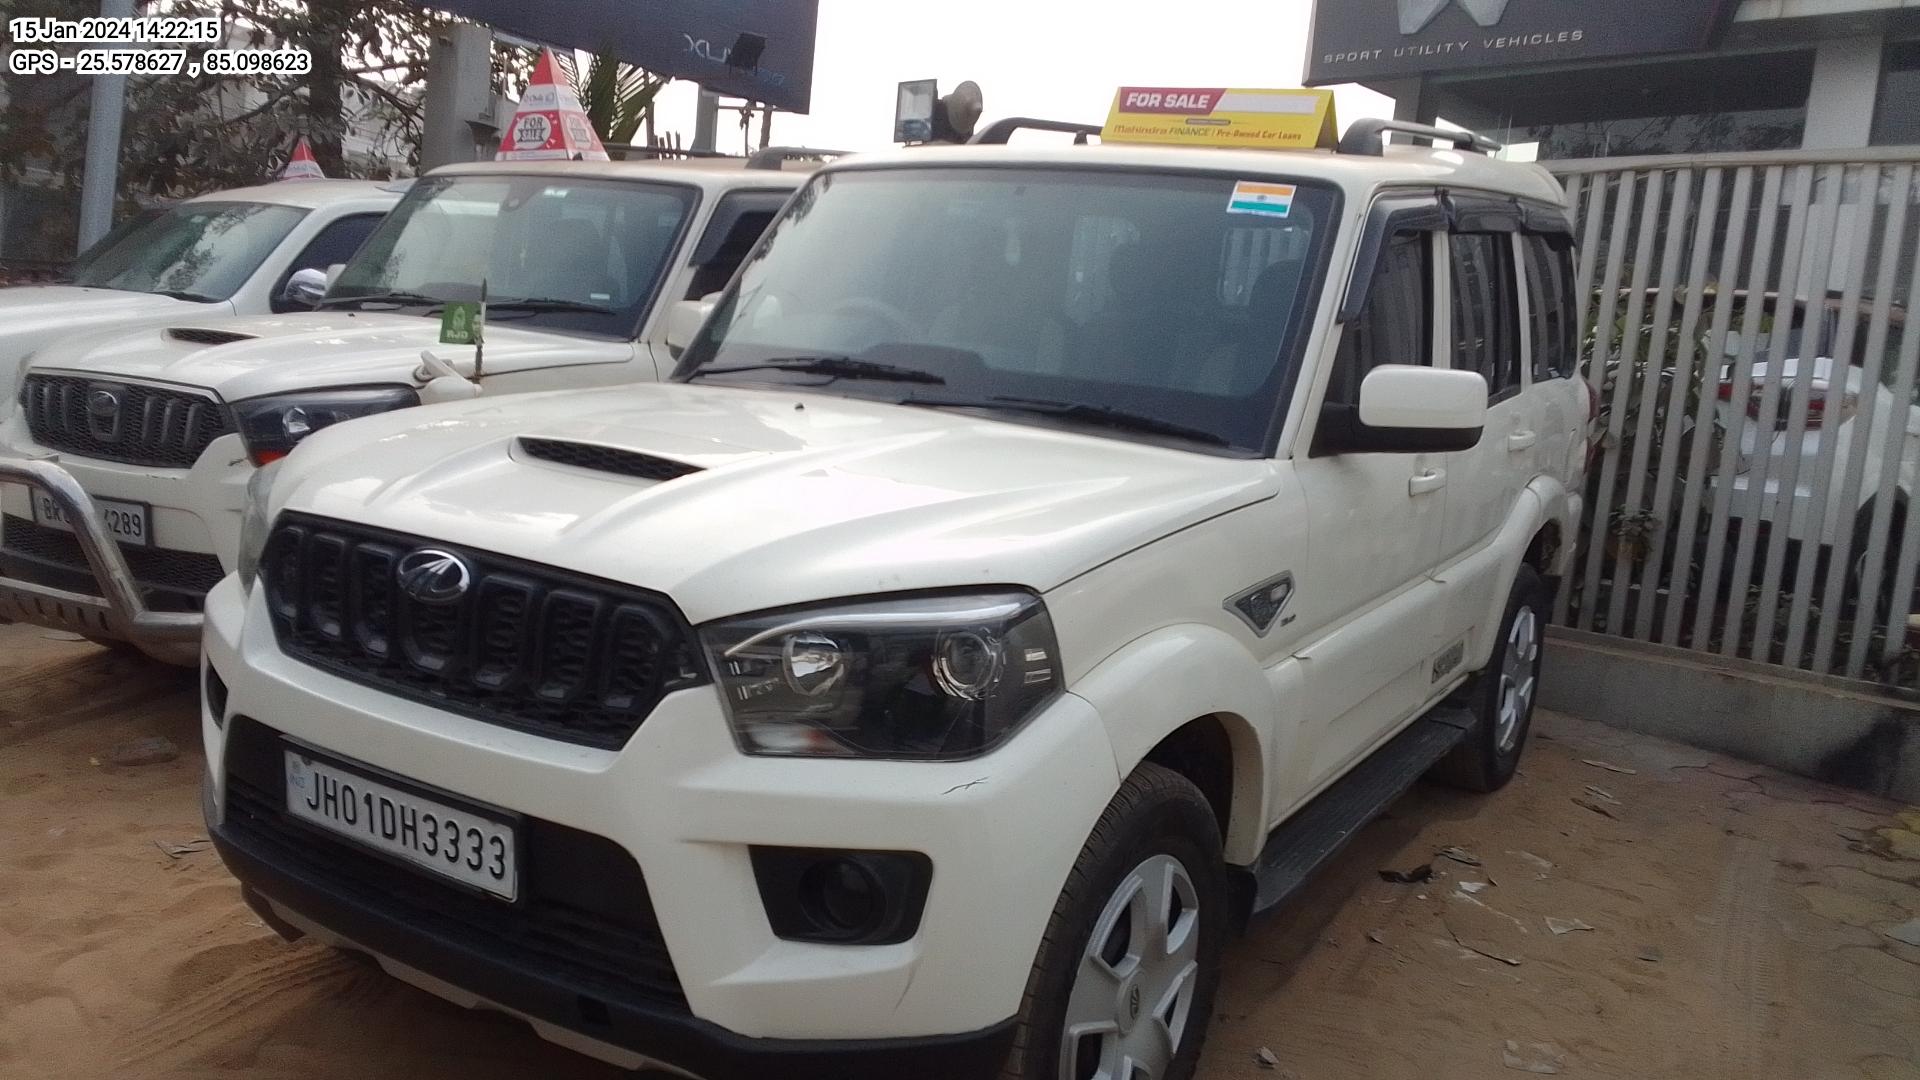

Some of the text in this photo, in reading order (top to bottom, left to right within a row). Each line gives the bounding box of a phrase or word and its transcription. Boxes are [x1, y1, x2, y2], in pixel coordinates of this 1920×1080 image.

[1323, 30, 1584, 63] SPORT UTILITY VEHICLES
[1125, 92, 1211, 109] FOR SALE
[523, 117, 544, 129] FOR
[1168, 127, 1211, 136] FINANCE
[306, 772, 506, 881] JH01DH3333
